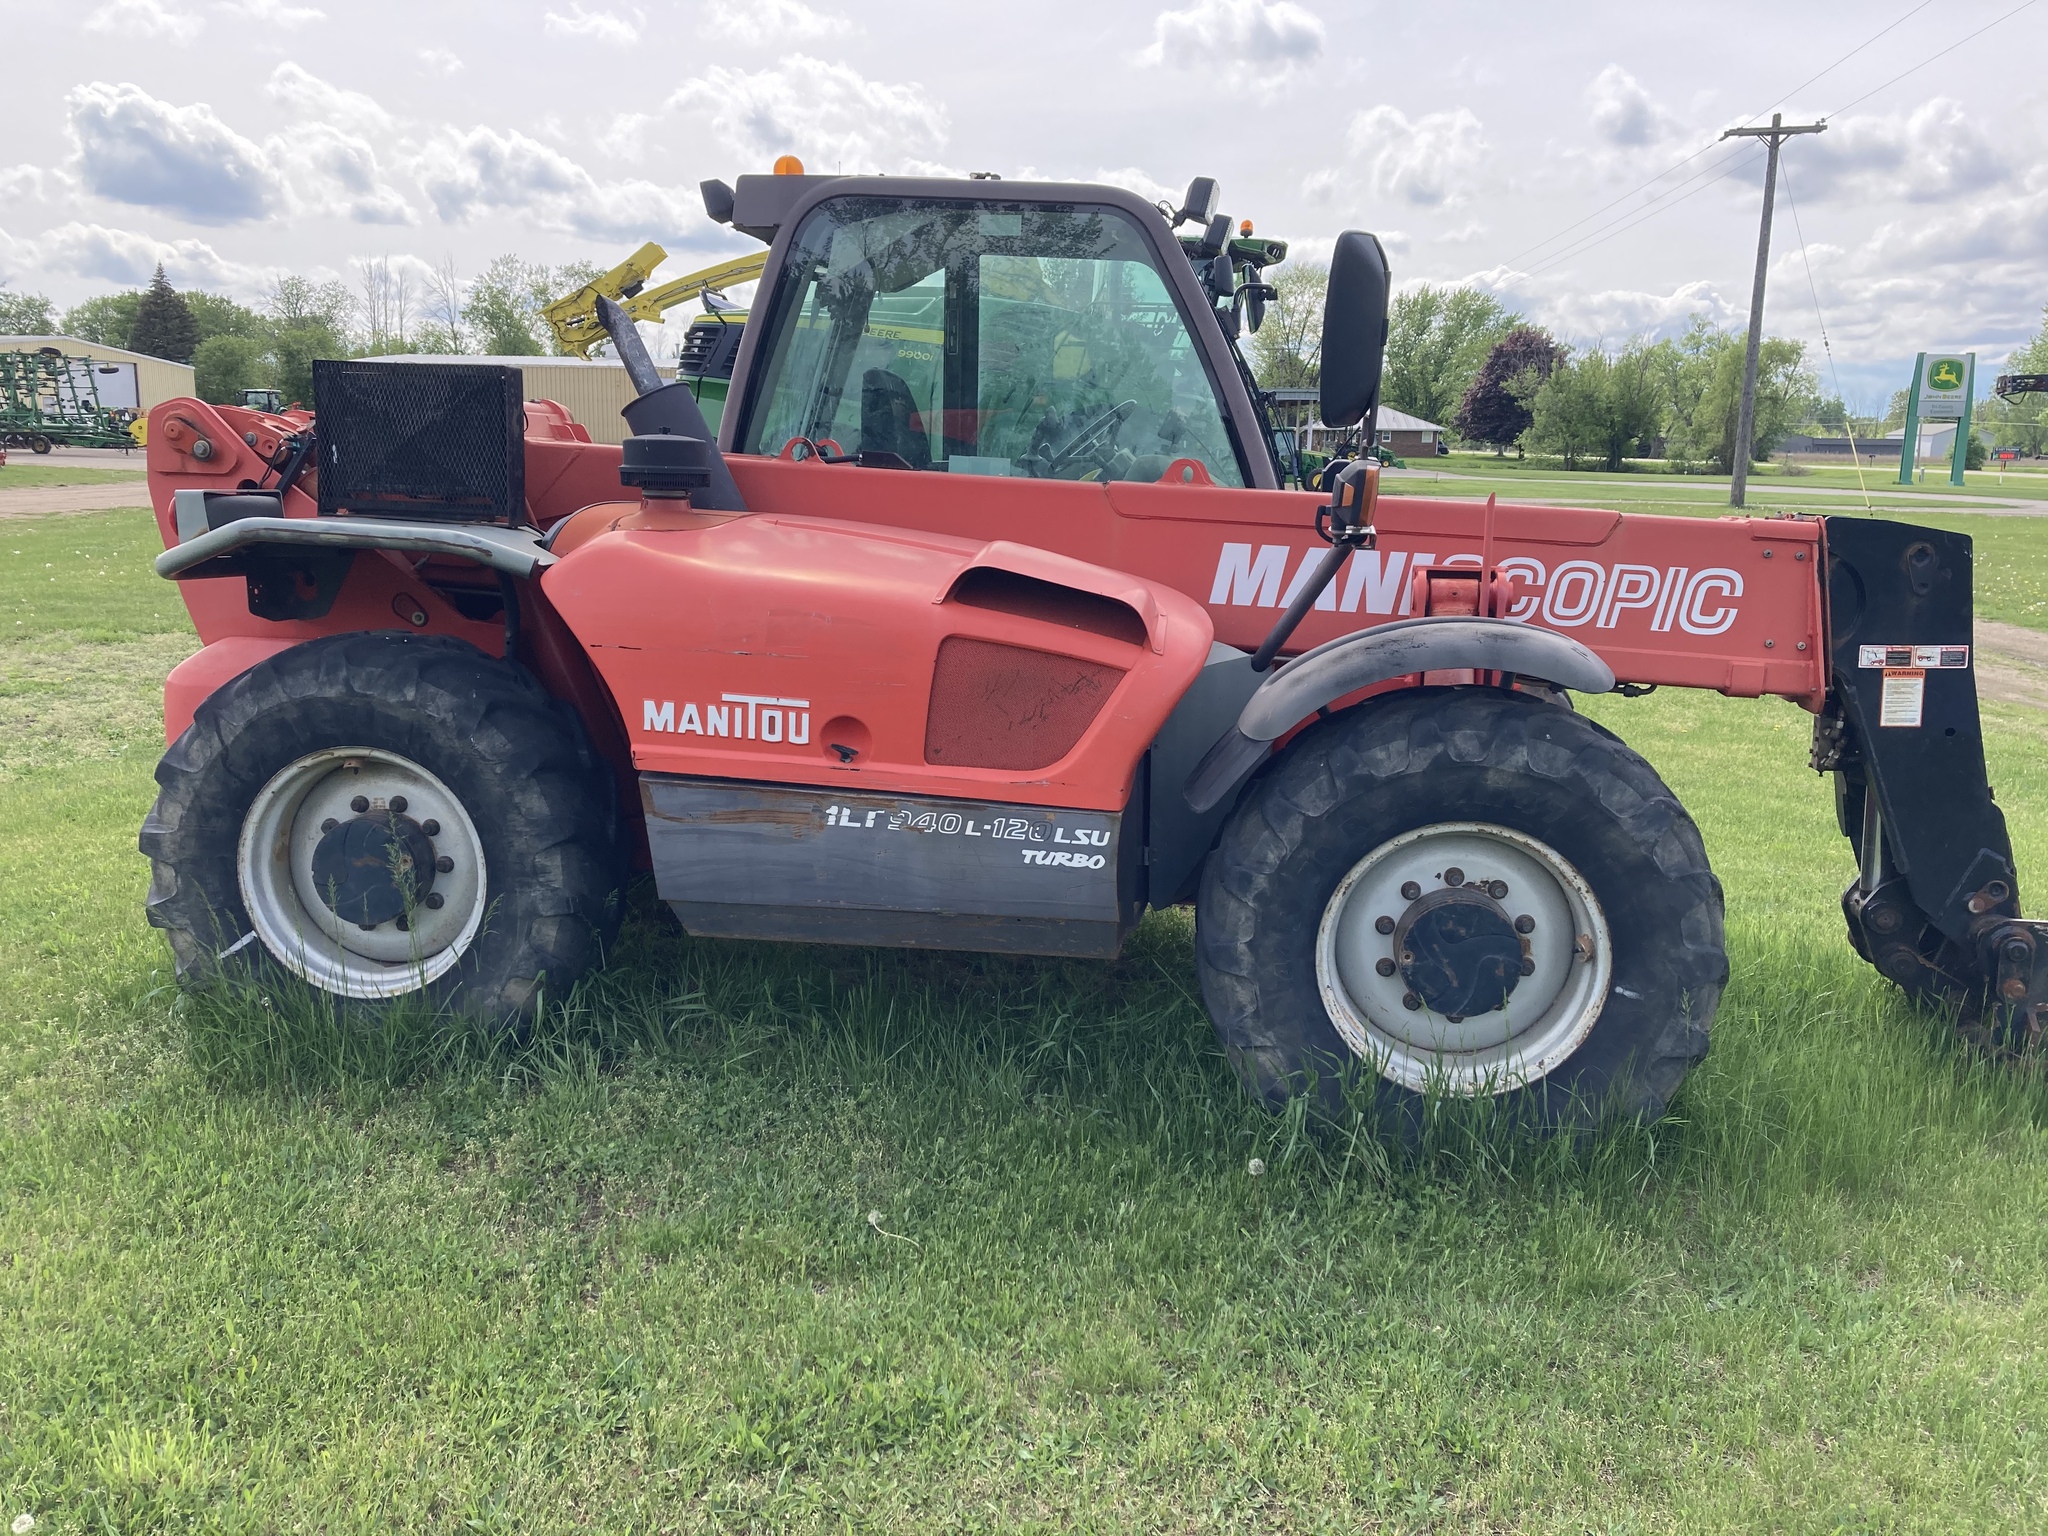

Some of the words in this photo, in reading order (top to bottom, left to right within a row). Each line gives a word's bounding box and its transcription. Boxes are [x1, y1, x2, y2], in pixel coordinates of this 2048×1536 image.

[864, 327, 902, 339] EERE
[1208, 541, 1745, 636] MANICOPIC
[642, 692, 811, 746] MANITOU
[1021, 849, 1106, 870] TURBO
